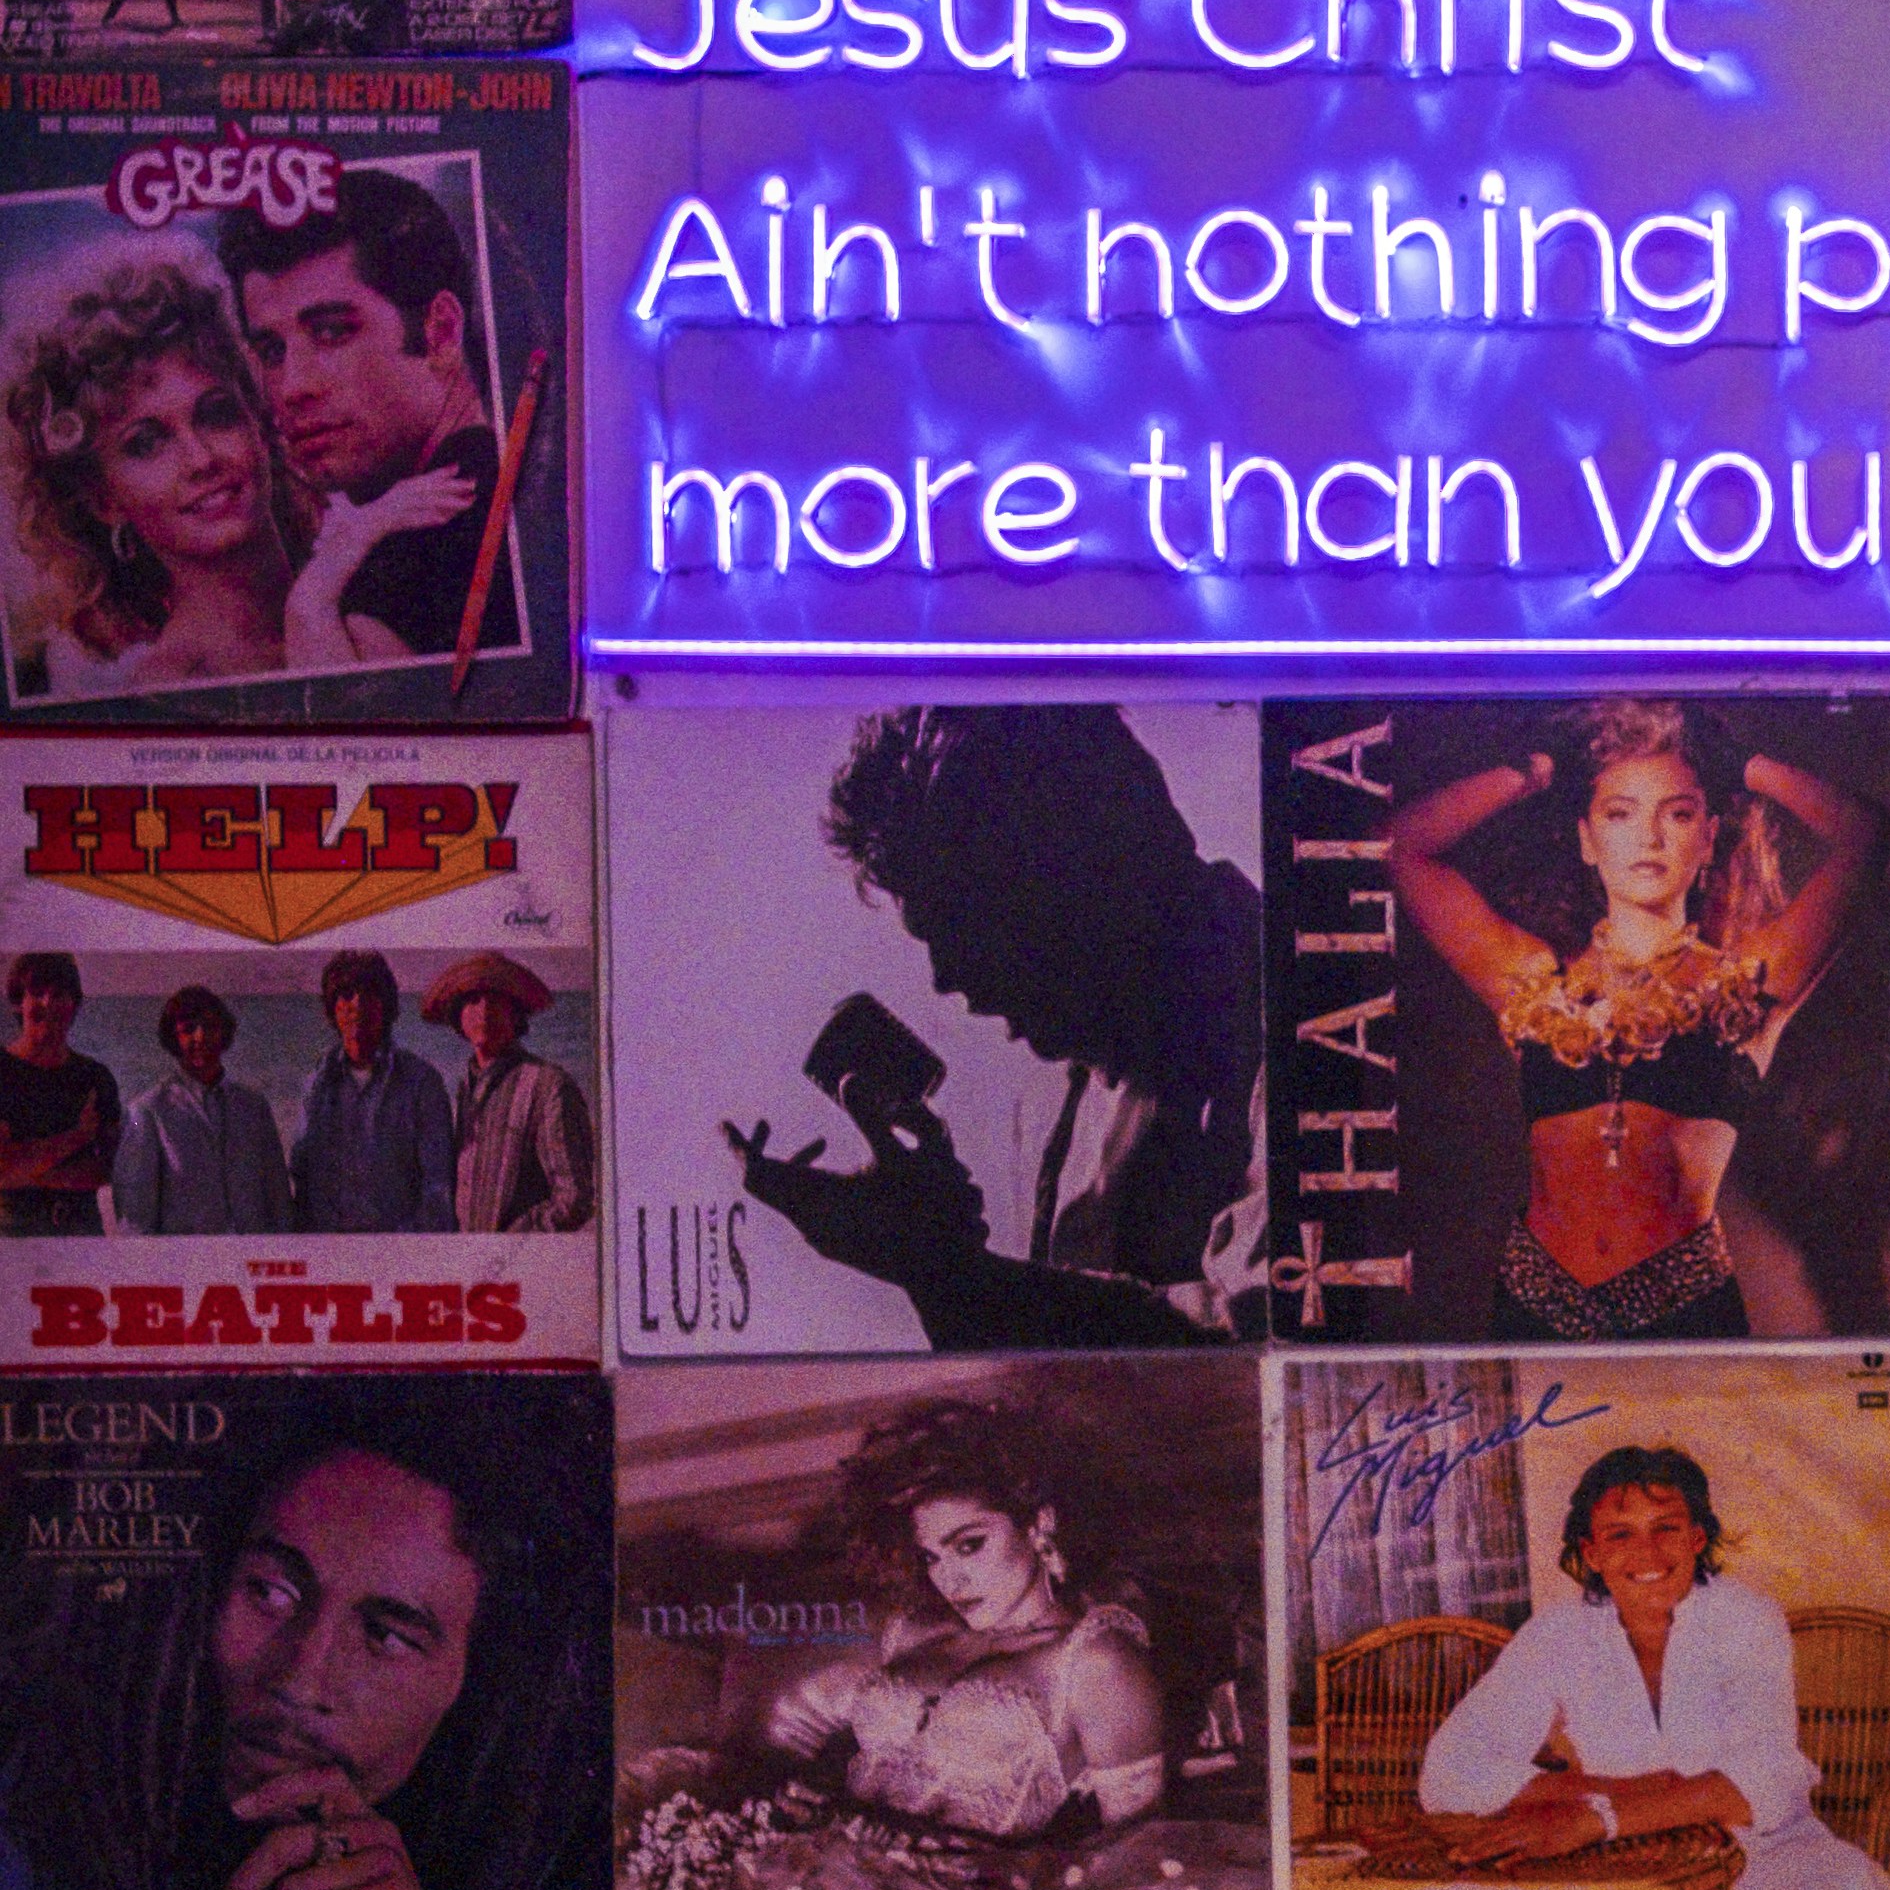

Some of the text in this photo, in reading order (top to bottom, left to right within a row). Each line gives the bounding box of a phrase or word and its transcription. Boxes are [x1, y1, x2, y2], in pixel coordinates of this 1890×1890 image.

[20, 72, 162, 111] TRAVOLTA
[219, 71, 317, 110] OLIVIA
[118, 144, 340, 229] GREASE
[634, 173, 1034, 331] Ain't
[1085, 170, 1729, 347] nothing
[649, 427, 1882, 602] more than you
[22, 781, 520, 876] HELP!
[1270, 713, 1415, 1329] THALIA
[248, 1257, 308, 1280] THE
[29, 1282, 529, 1349] BEATLES
[0, 1401, 227, 1445] LEGEND
[1316, 1380, 1477, 1476] Luis
[75, 1480, 156, 1512] BOB
[1308, 1380, 1612, 1566] Miguel
[27, 1514, 202, 1547] MARLEY
[640, 1582, 869, 1639] madonna
